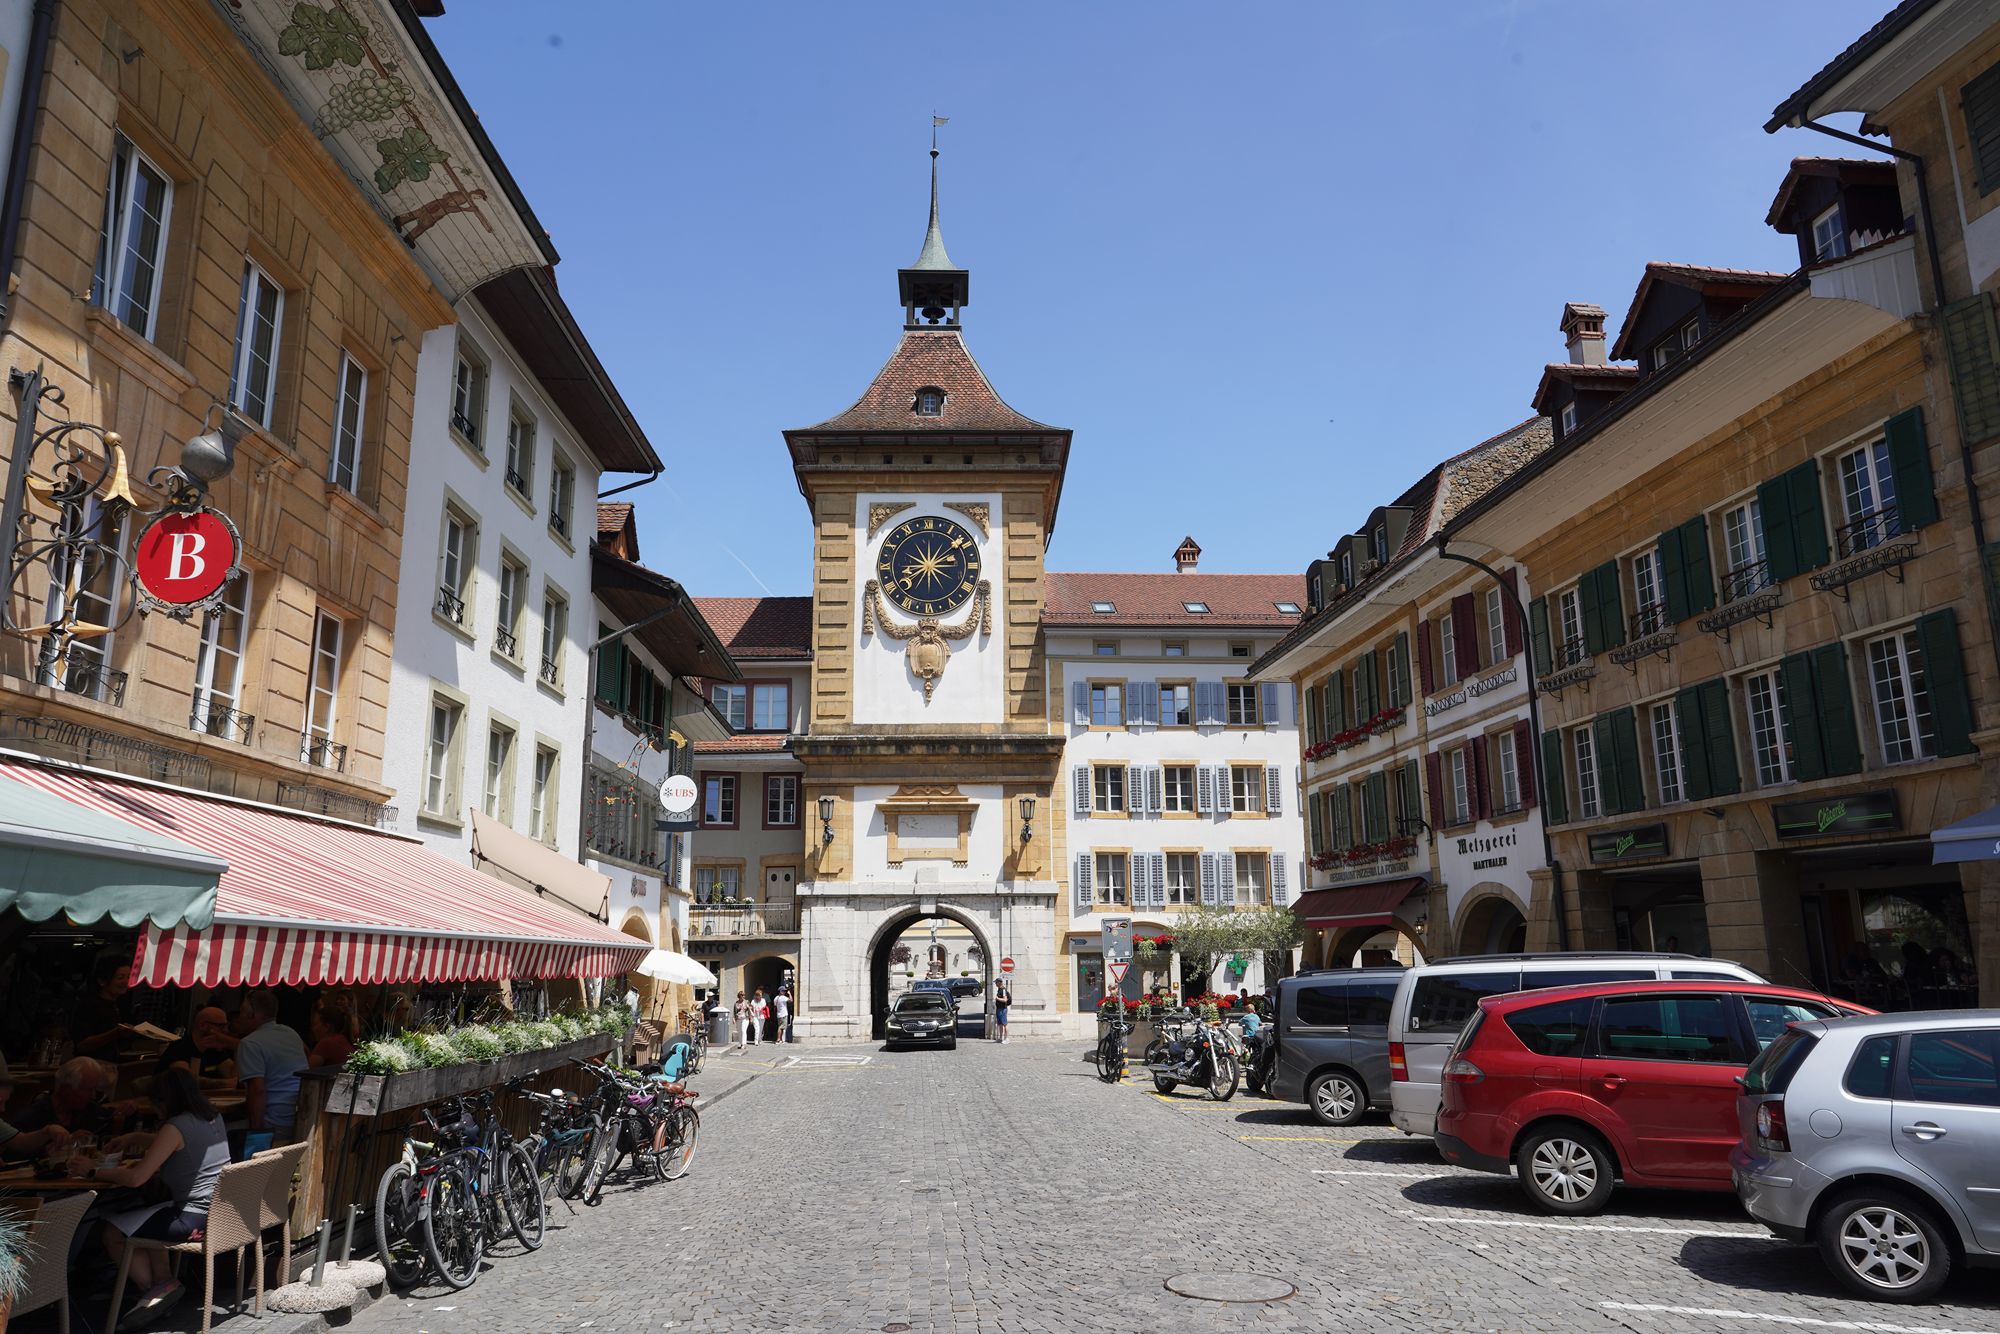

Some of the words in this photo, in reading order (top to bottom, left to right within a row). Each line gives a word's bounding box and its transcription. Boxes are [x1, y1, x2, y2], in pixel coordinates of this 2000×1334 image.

[924, 520, 933, 529] XII
[947, 525, 955, 534] I
[901, 525, 912, 536] XI
[885, 541, 897, 550] X
[164, 533, 206, 580] B
[948, 597, 957, 608] V
[925, 603, 934, 613] VI
[675, 788, 694, 798] UBS
[1456, 827, 1517, 855] Metzgerei
[688, 942, 740, 954] NTOR
